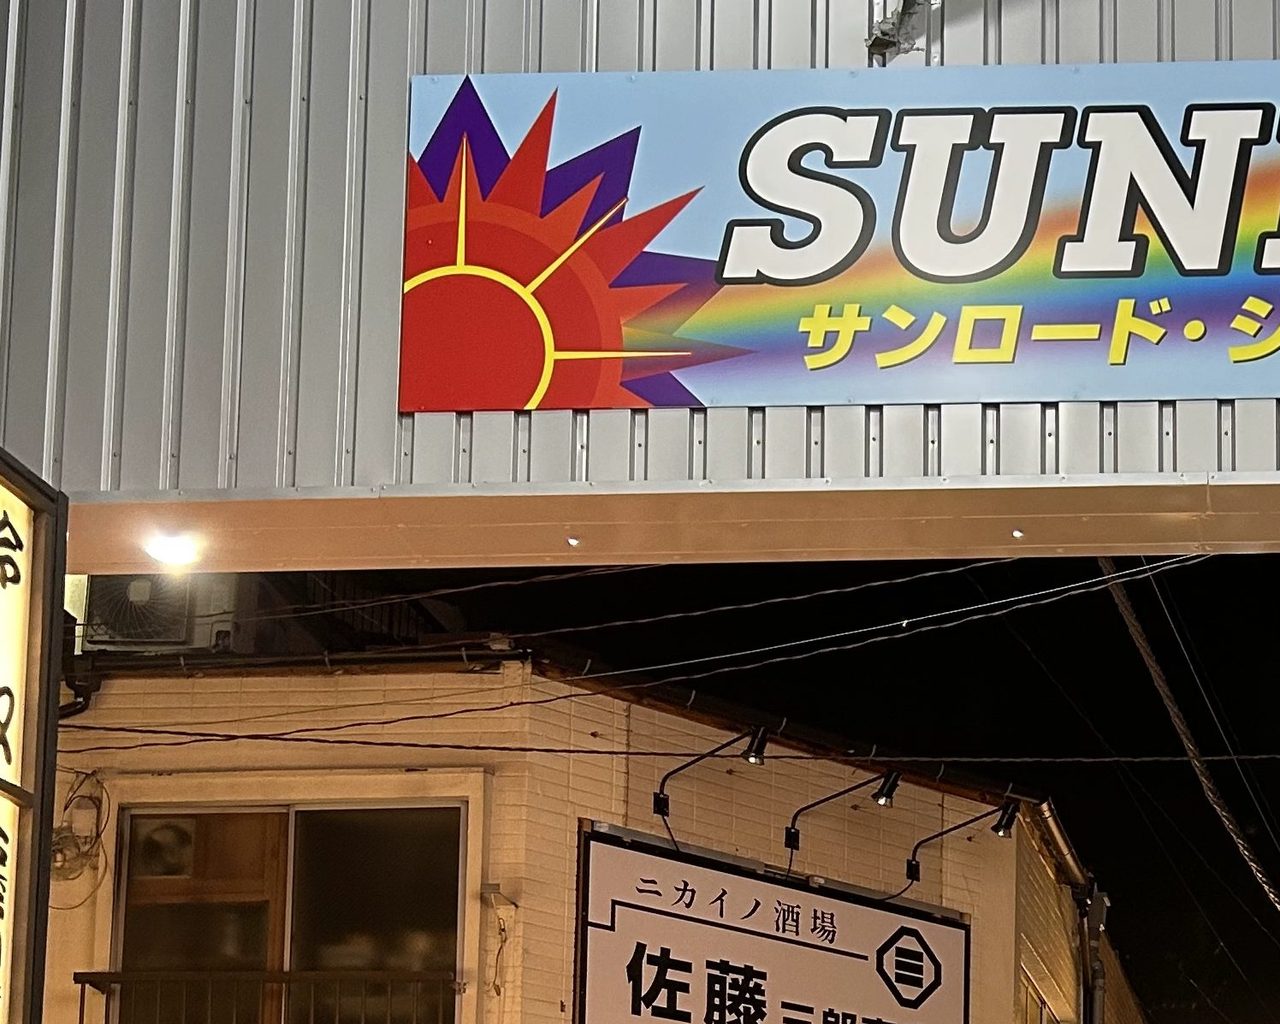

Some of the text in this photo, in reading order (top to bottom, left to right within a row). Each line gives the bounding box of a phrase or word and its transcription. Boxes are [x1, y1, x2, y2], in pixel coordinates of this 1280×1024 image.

[634, 876, 838, 946] ニカイノ酒場
